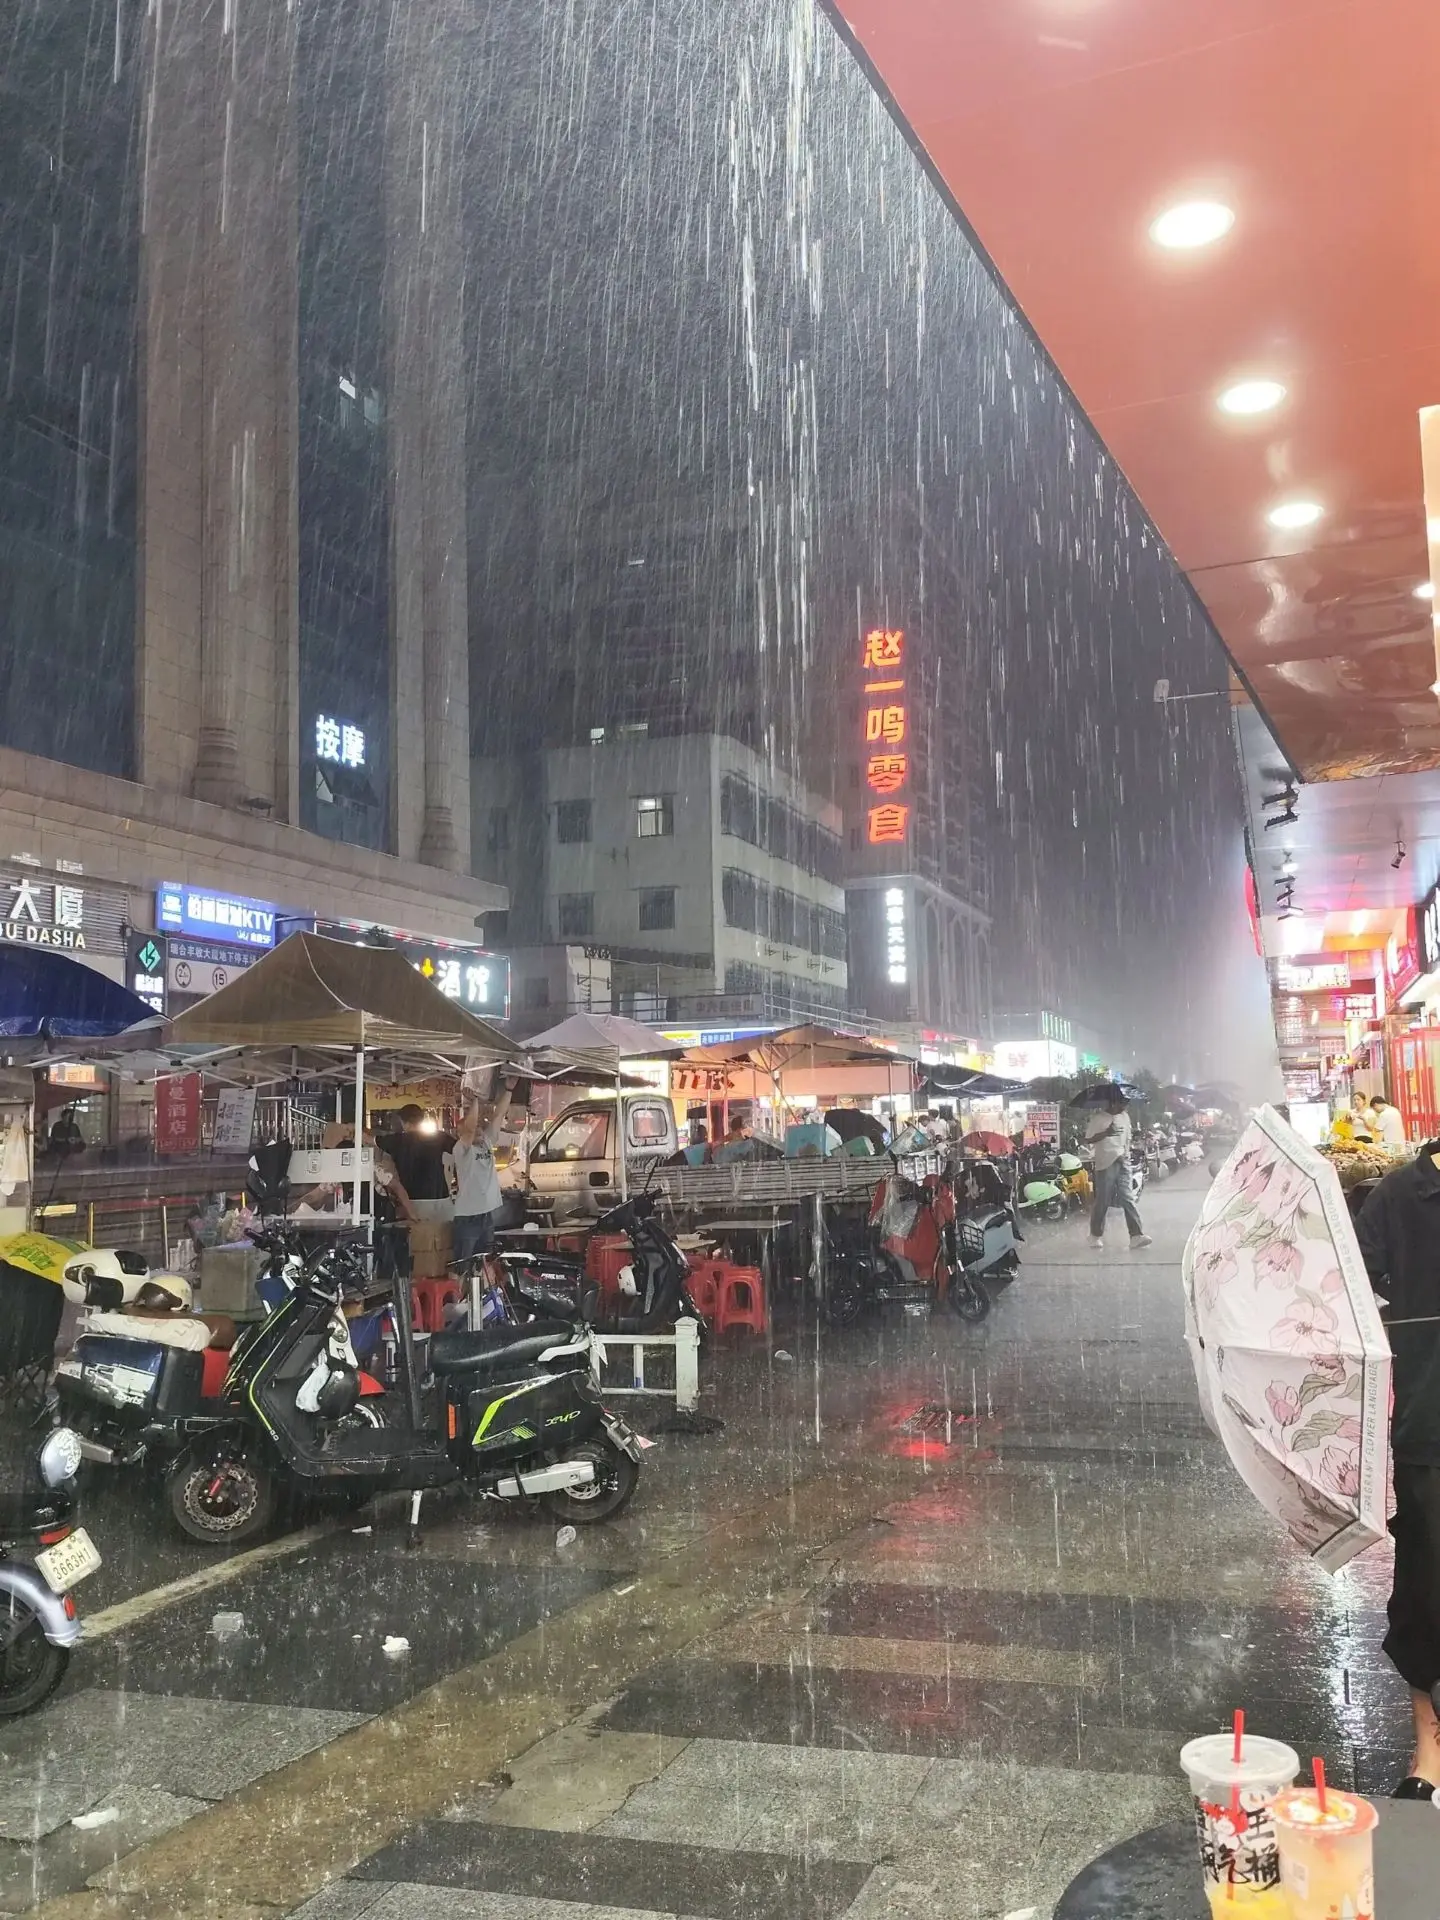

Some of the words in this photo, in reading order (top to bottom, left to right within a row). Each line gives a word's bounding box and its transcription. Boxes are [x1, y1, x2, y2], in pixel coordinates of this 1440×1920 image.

[863, 629, 908, 844] 赵一鸣零食
[10, 879, 84, 928] 大厦
[27, 925, 86, 949] DASHA
[214, 973, 225, 986] 15
[1367, 1362, 1379, 1418] LANGUAGE
[1365, 1418, 1376, 1457] FLOWER
[1363, 1460, 1373, 1513] FRAGRANT
